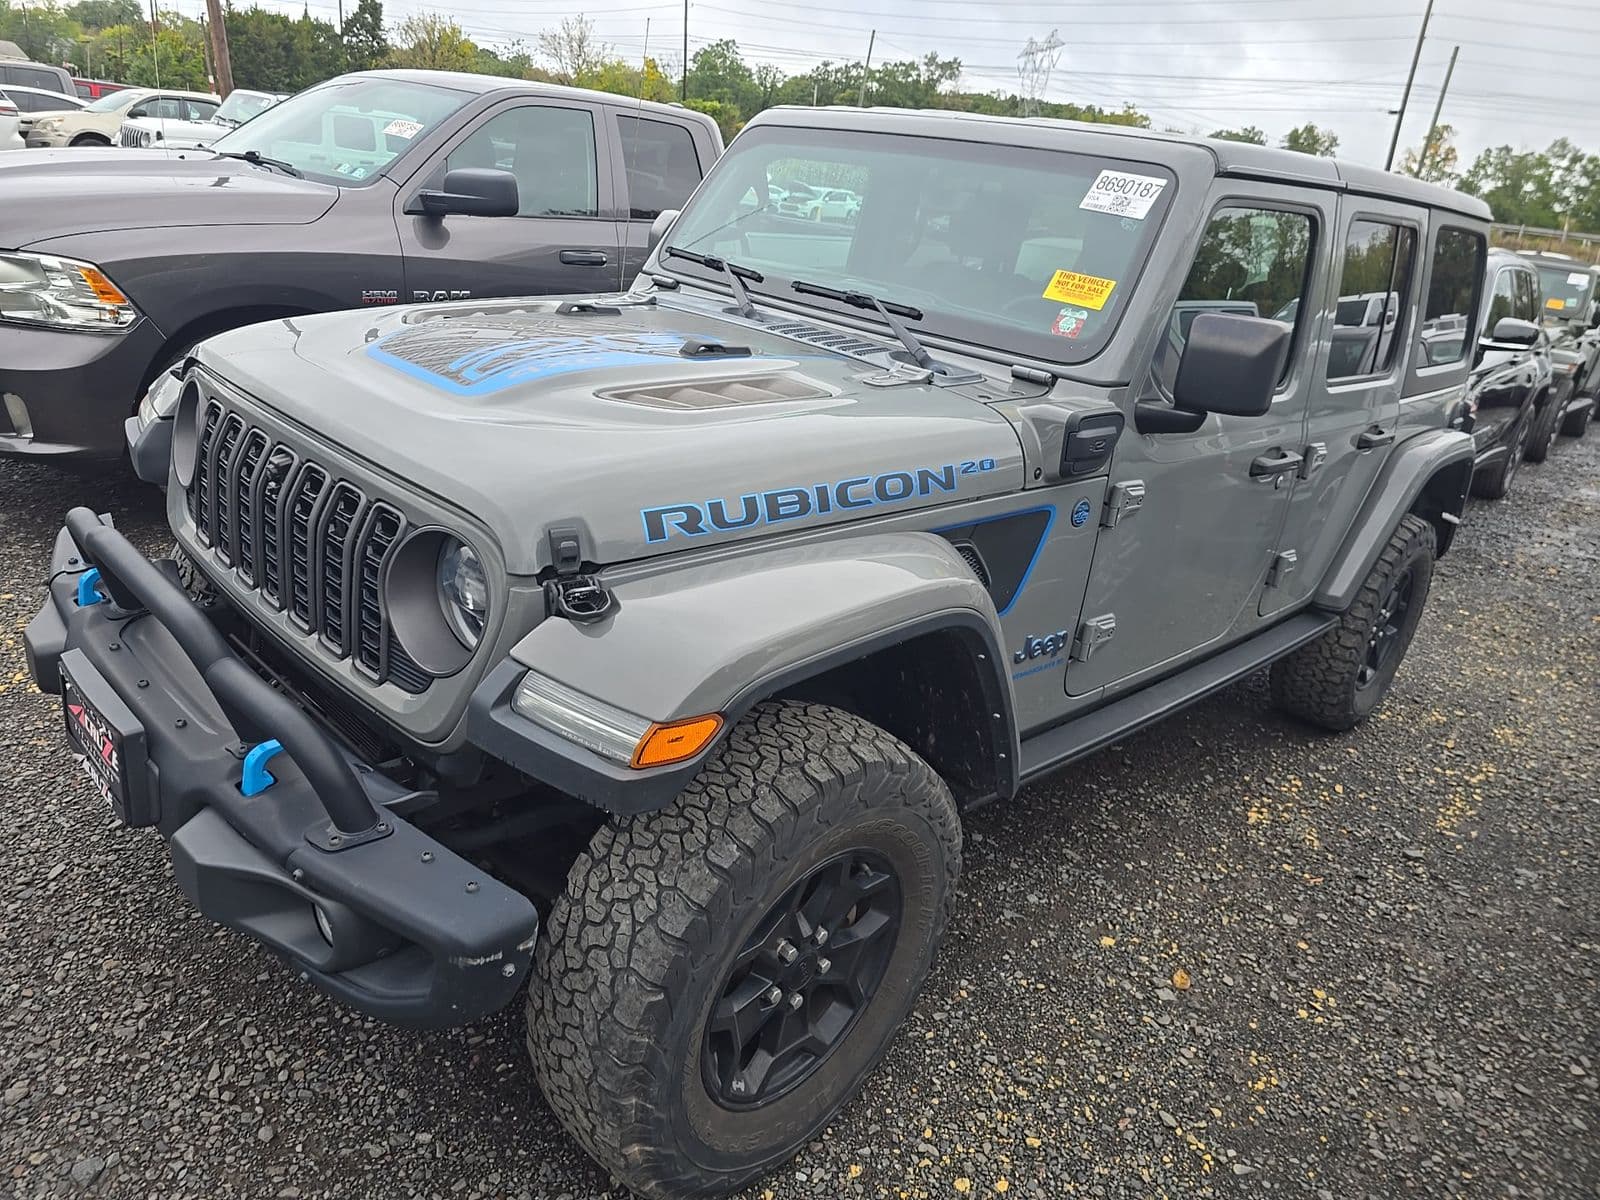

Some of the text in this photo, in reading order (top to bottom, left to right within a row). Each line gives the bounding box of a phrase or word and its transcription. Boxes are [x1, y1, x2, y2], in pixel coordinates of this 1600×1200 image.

[1096, 175, 1164, 199] 8690187
[1055, 279, 1071, 287] NOT
[1070, 281, 1086, 291] FOR
[1086, 286, 1107, 295] SALE
[1058, 271, 1113, 289] THIS VEHICLE
[362, 290, 398, 298] HEMI
[413, 290, 471, 302] RAM
[640, 464, 959, 544] RUBICON
[1013, 630, 1068, 665] Jeep
